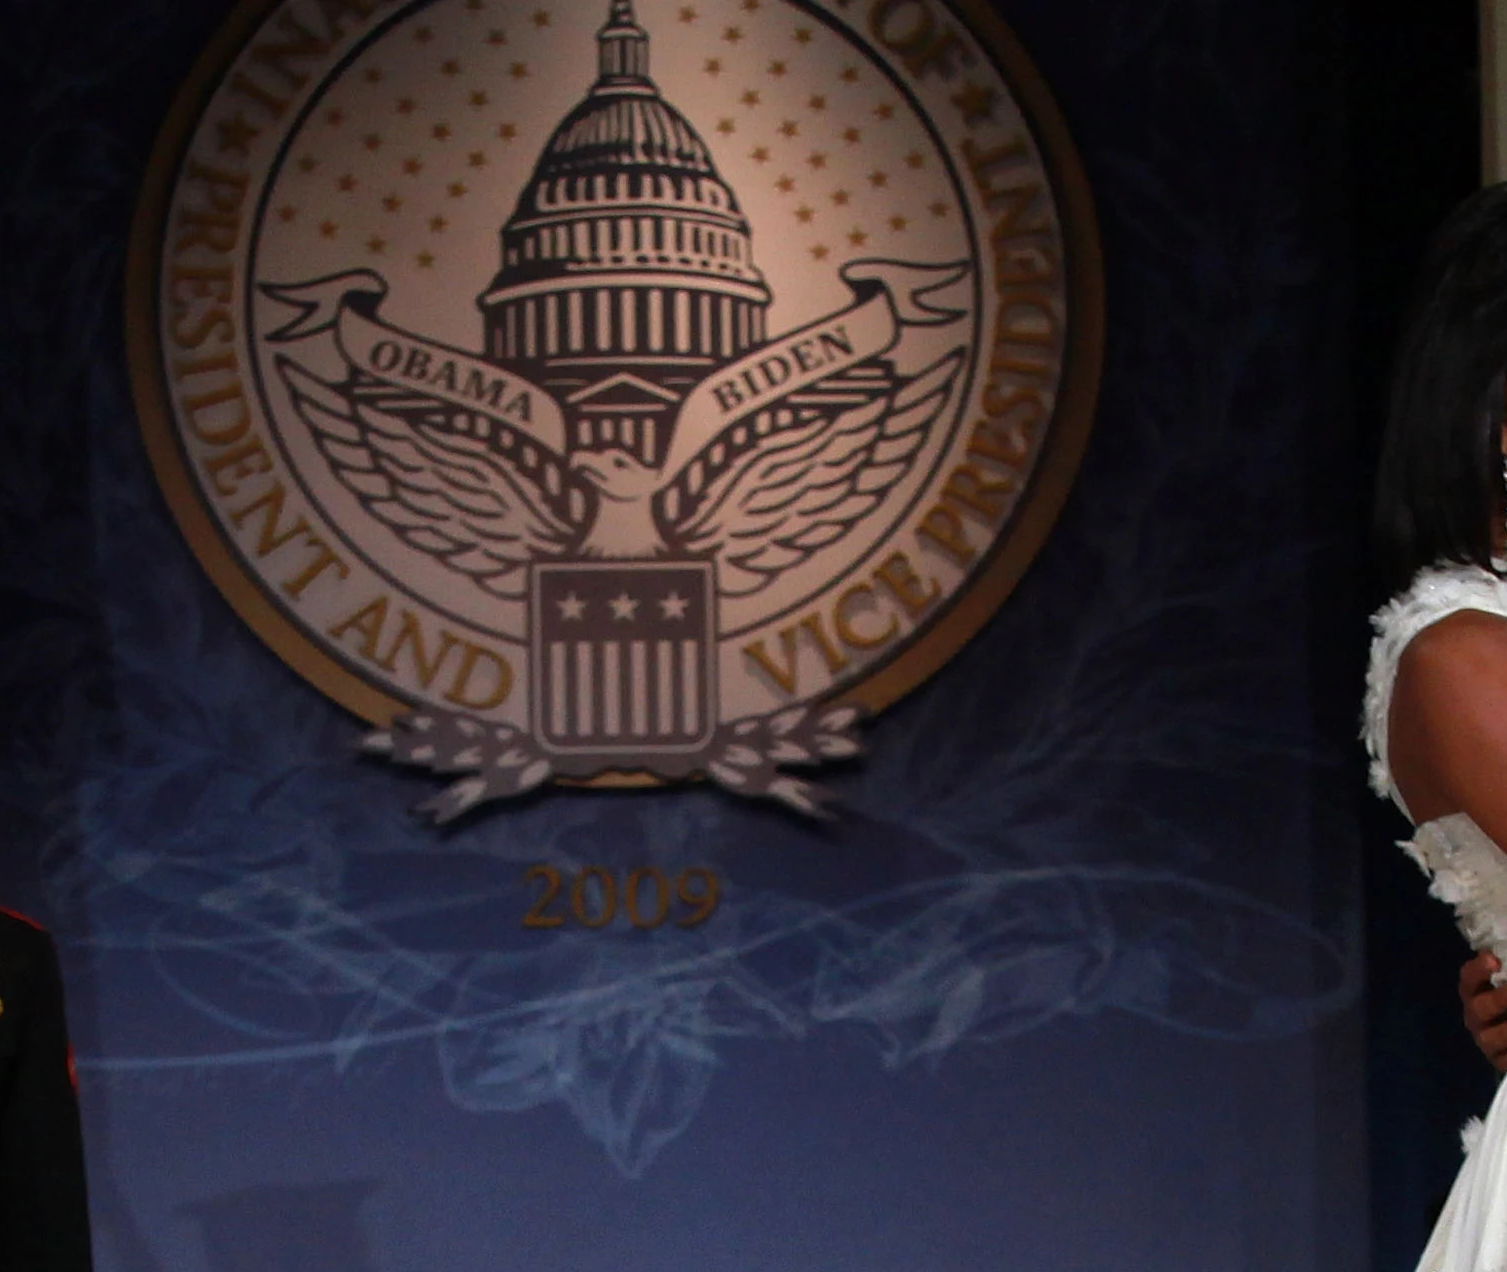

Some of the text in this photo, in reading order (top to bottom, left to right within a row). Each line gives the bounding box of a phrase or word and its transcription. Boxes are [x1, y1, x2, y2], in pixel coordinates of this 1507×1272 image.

[369, 340, 534, 423] OBAMA
[713, 325, 855, 414] BIDEN
[169, 136, 1058, 710] PRESIDENT AND VICE PRESIDENT
[522, 864, 720, 929] 2009
